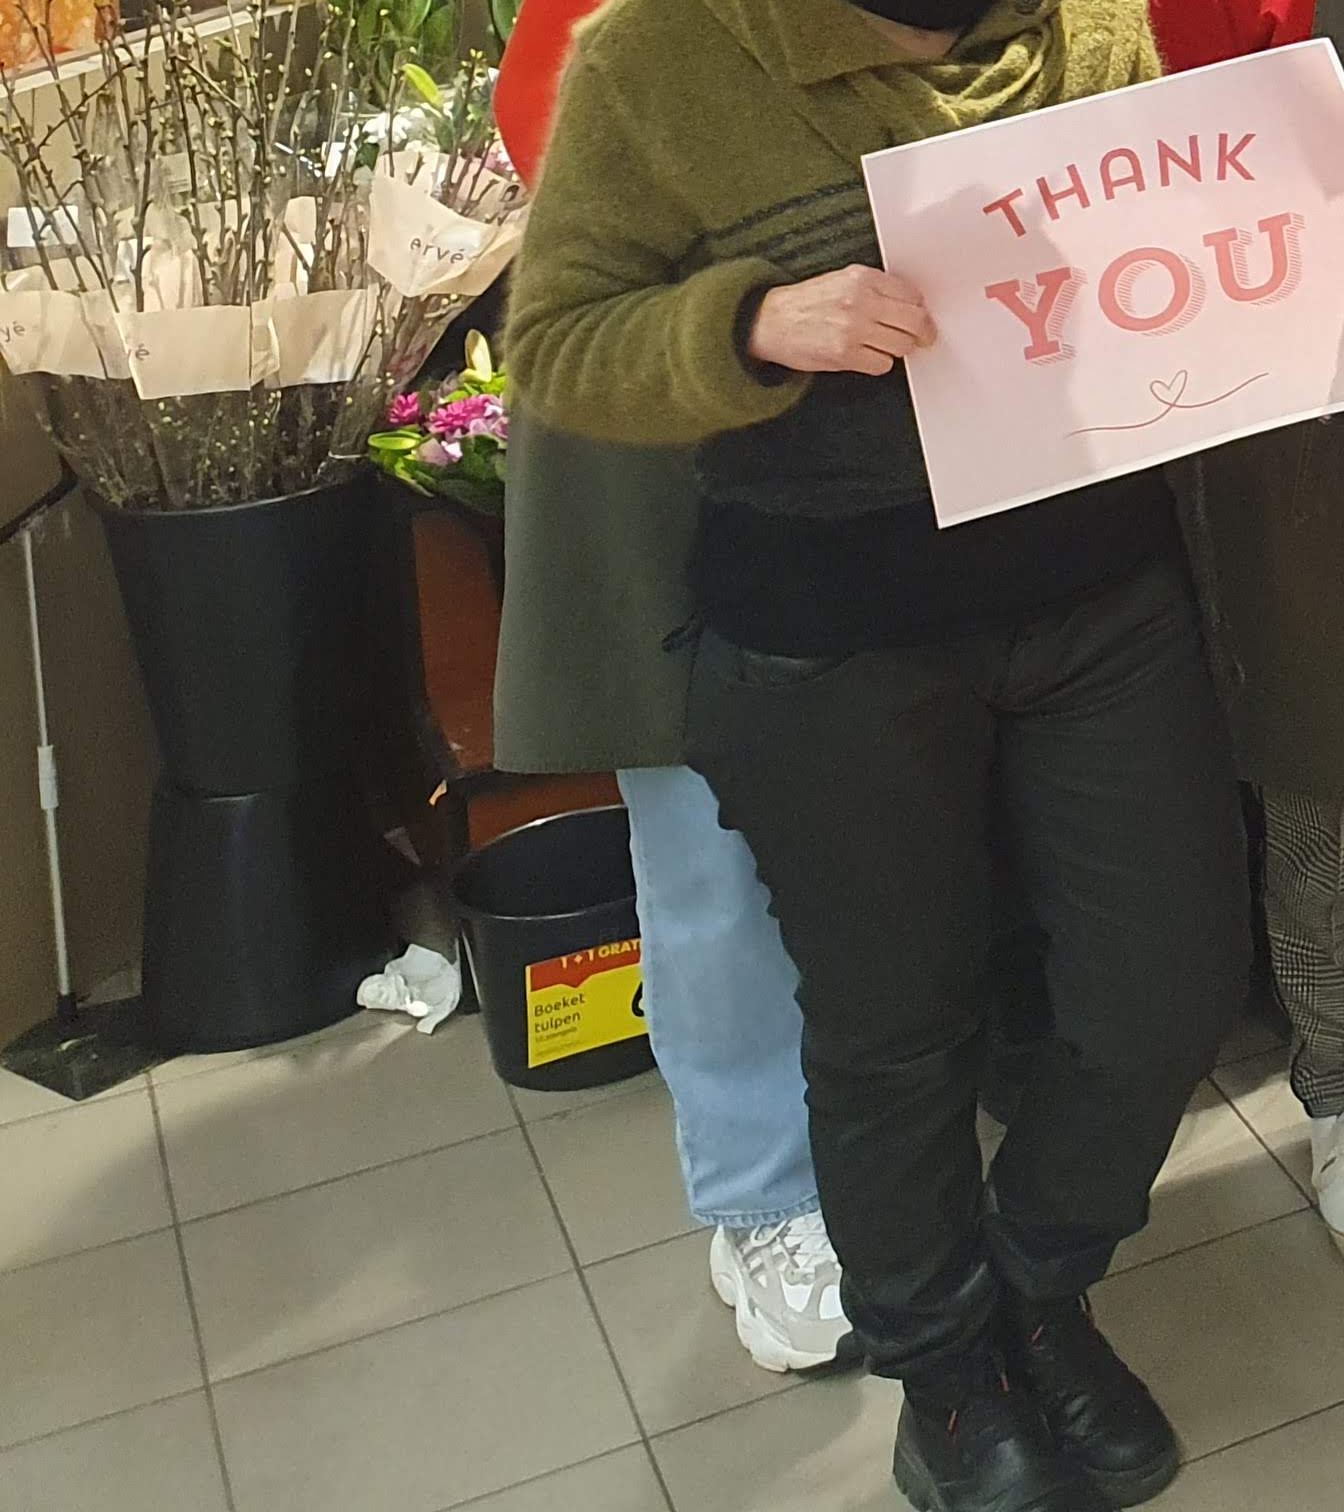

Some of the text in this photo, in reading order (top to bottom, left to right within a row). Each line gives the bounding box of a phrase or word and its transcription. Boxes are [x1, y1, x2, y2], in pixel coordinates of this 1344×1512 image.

[983, 133, 1257, 238] THANK
[985, 211, 1305, 368] YOU
[534, 993, 586, 1017] Boeket
[535, 1011, 581, 1033] tulpen
